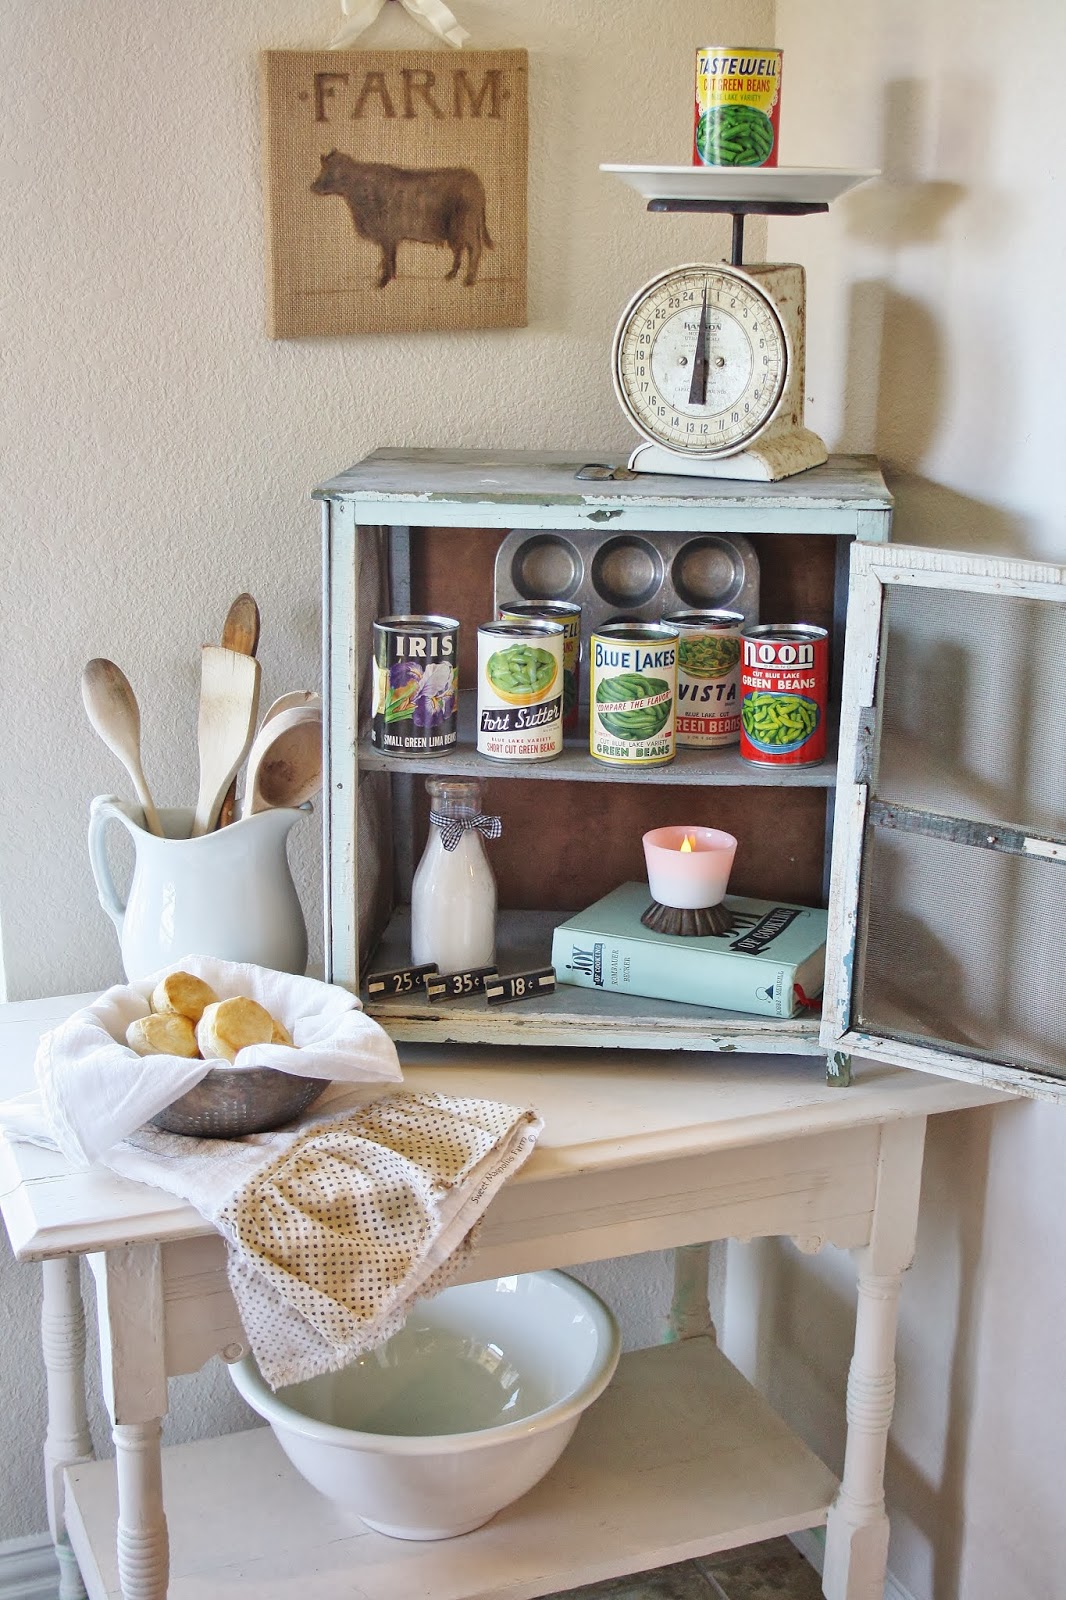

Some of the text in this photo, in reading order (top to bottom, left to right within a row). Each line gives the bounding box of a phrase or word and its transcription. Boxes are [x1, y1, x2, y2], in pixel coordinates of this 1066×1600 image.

[699, 57, 776, 76] TASTEWELL
[703, 78, 772, 92] CT GREEN BEANS
[313, 67, 501, 123] FARM
[683, 291, 694, 301] 24
[668, 297, 680, 308] 23
[730, 298, 736, 308] 2
[655, 308, 666, 319] 22
[742, 308, 748, 318] 3
[646, 319, 655, 330] 21
[752, 321, 758, 332] 4
[639, 333, 651, 344] 20
[759, 338, 765, 349] 5
[636, 350, 645, 361] 19
[762, 355, 769, 366] 6
[636, 366, 645, 377] 18
[641, 381, 650, 393] 17
[754, 389, 760, 400] 8
[648, 395, 657, 406] 16
[657, 406, 666, 417] 15
[744, 402, 750, 413] 9
[671, 416, 680, 427] 14
[731, 412, 739, 423] 10
[686, 422, 695, 433] 13
[700, 423, 709, 434] 12
[718, 419, 725, 431] 11
[395, 635, 453, 658] IRIS
[595, 643, 631, 668] BLUE
[635, 649, 675, 673] LAKES
[752, 670, 763, 678] CUT
[742, 675, 816, 690] GREEN BEANS
[678, 683, 736, 702] VISTA
[630, 698, 644, 709] THE
[482, 704, 560, 731] Fort Sutter
[676, 717, 741, 733] REEN BEANS
[383, 734, 403, 747] SMALL
[404, 736, 427, 748] GREEN
[428, 735, 444, 747] LIMA
[600, 737, 610, 745] CUT
[612, 739, 626, 748] BLUE
[646, 739, 668, 748] VARIETY
[486, 741, 556, 755] SHORT CUT GREEN BEANS
[596, 743, 670, 758] GREEN BEANS
[737, 937, 761, 949] OF
[753, 909, 795, 940] COOKING
